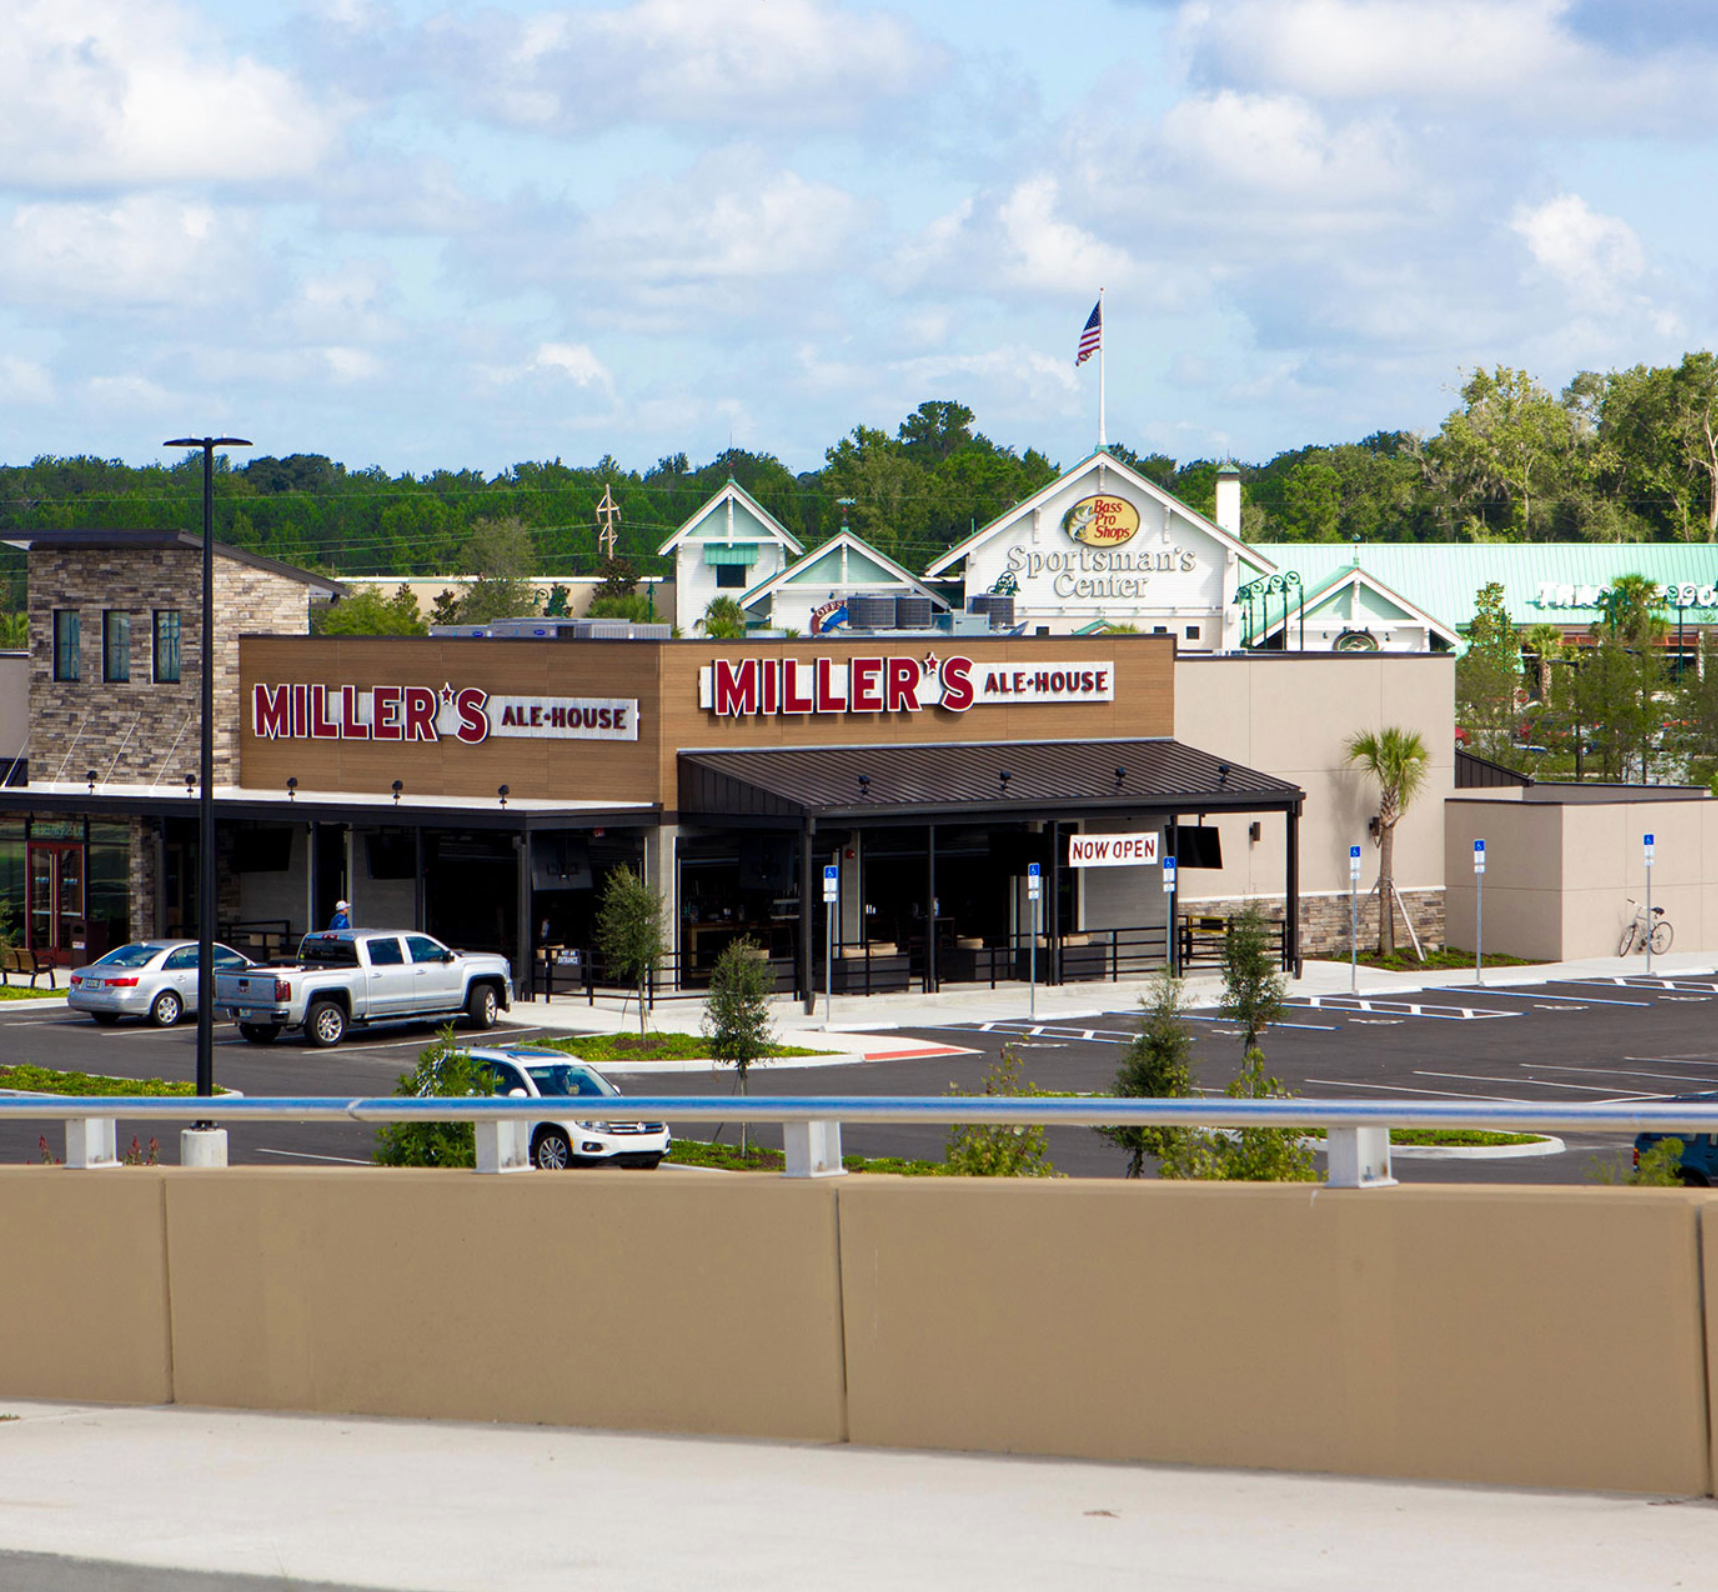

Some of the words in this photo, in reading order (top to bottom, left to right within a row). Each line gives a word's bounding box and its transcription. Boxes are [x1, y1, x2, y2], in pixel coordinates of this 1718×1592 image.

[1093, 499, 1122, 513] Bass
[1094, 513, 1116, 526] Pro
[1094, 525, 1130, 540] Shops
[1007, 544, 1196, 579] Sportsman's
[1054, 572, 1149, 599] Center
[1073, 841, 1110, 860] NOW
[1113, 839, 1154, 858] OPEN
